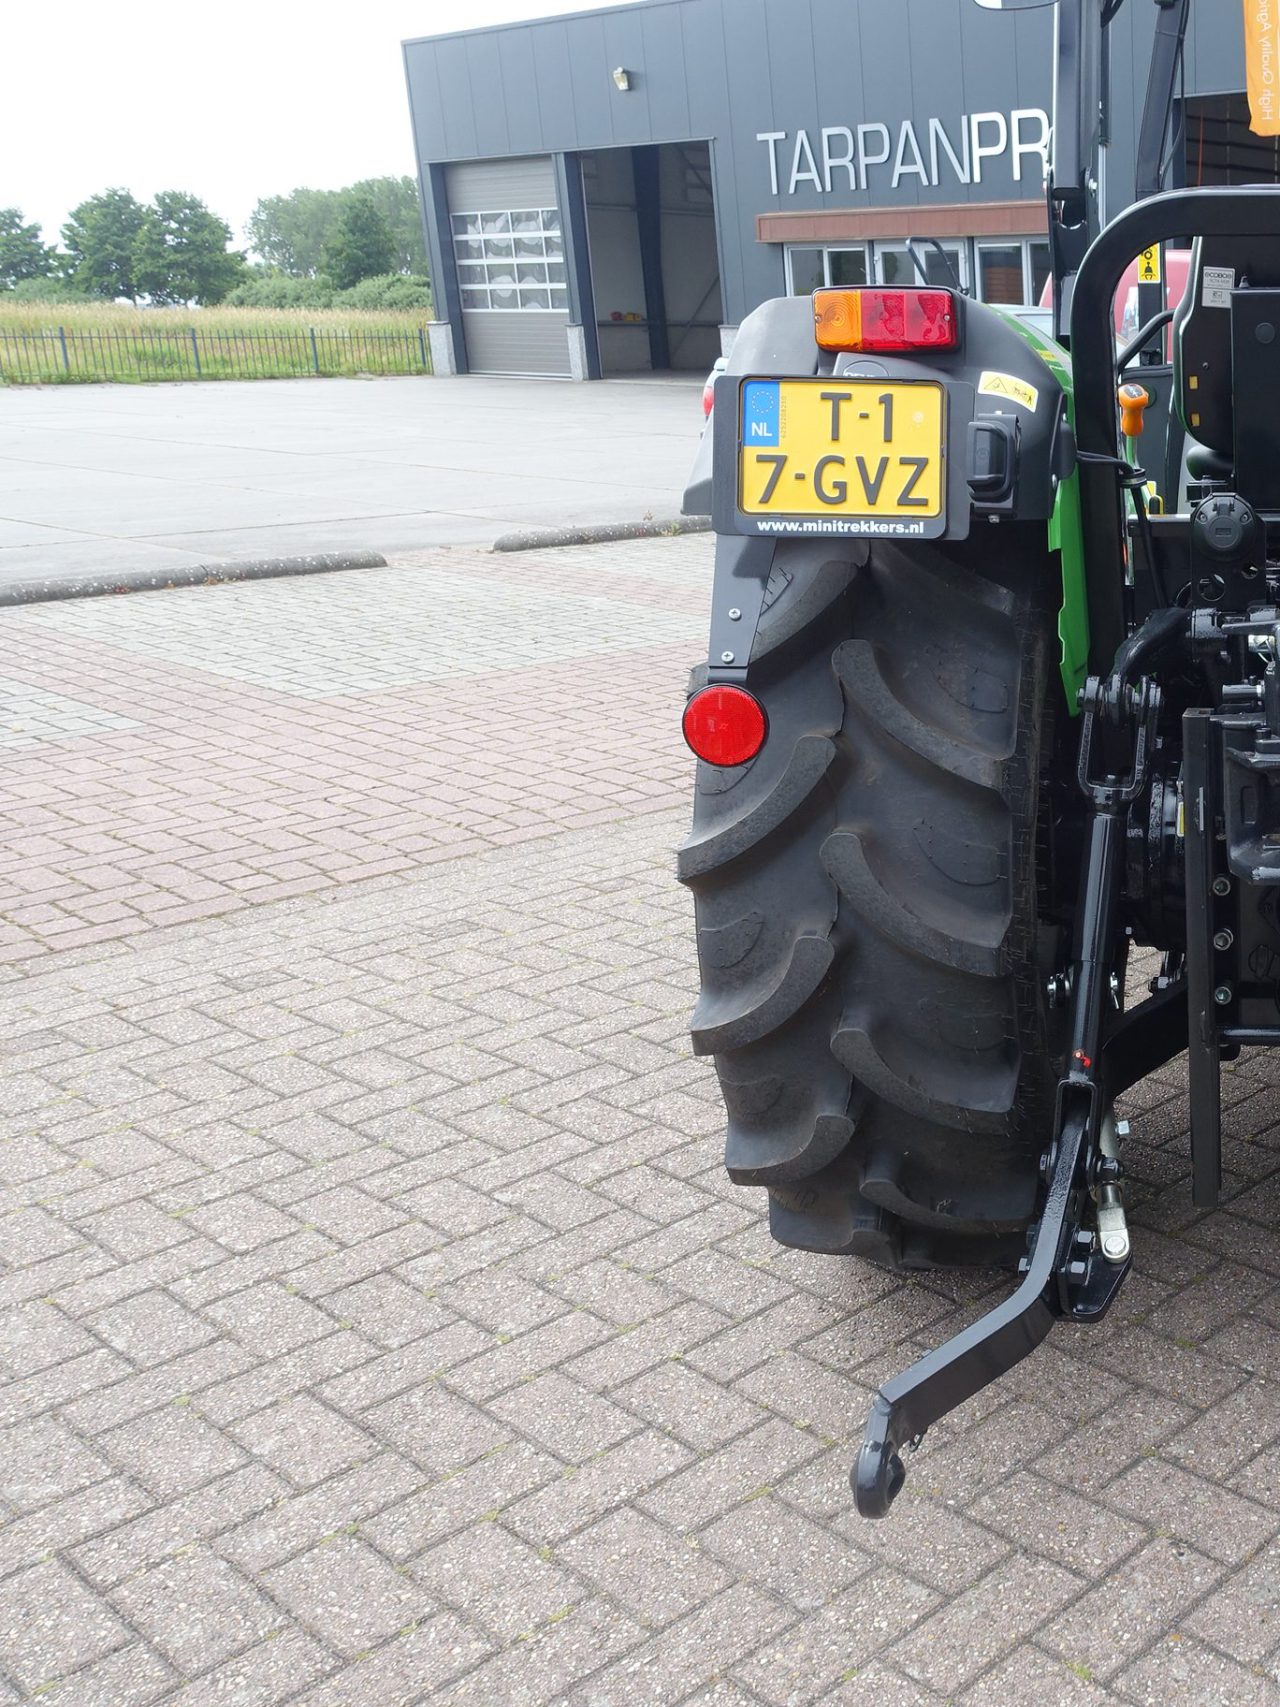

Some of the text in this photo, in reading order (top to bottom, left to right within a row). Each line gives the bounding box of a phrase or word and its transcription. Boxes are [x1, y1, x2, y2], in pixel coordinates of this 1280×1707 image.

[751, 421, 773, 437] NL
[820, 391, 894, 443] T-1
[756, 454, 929, 507] 7-GVZ
[757, 520, 924, 534] www.minitrekkers.nl
